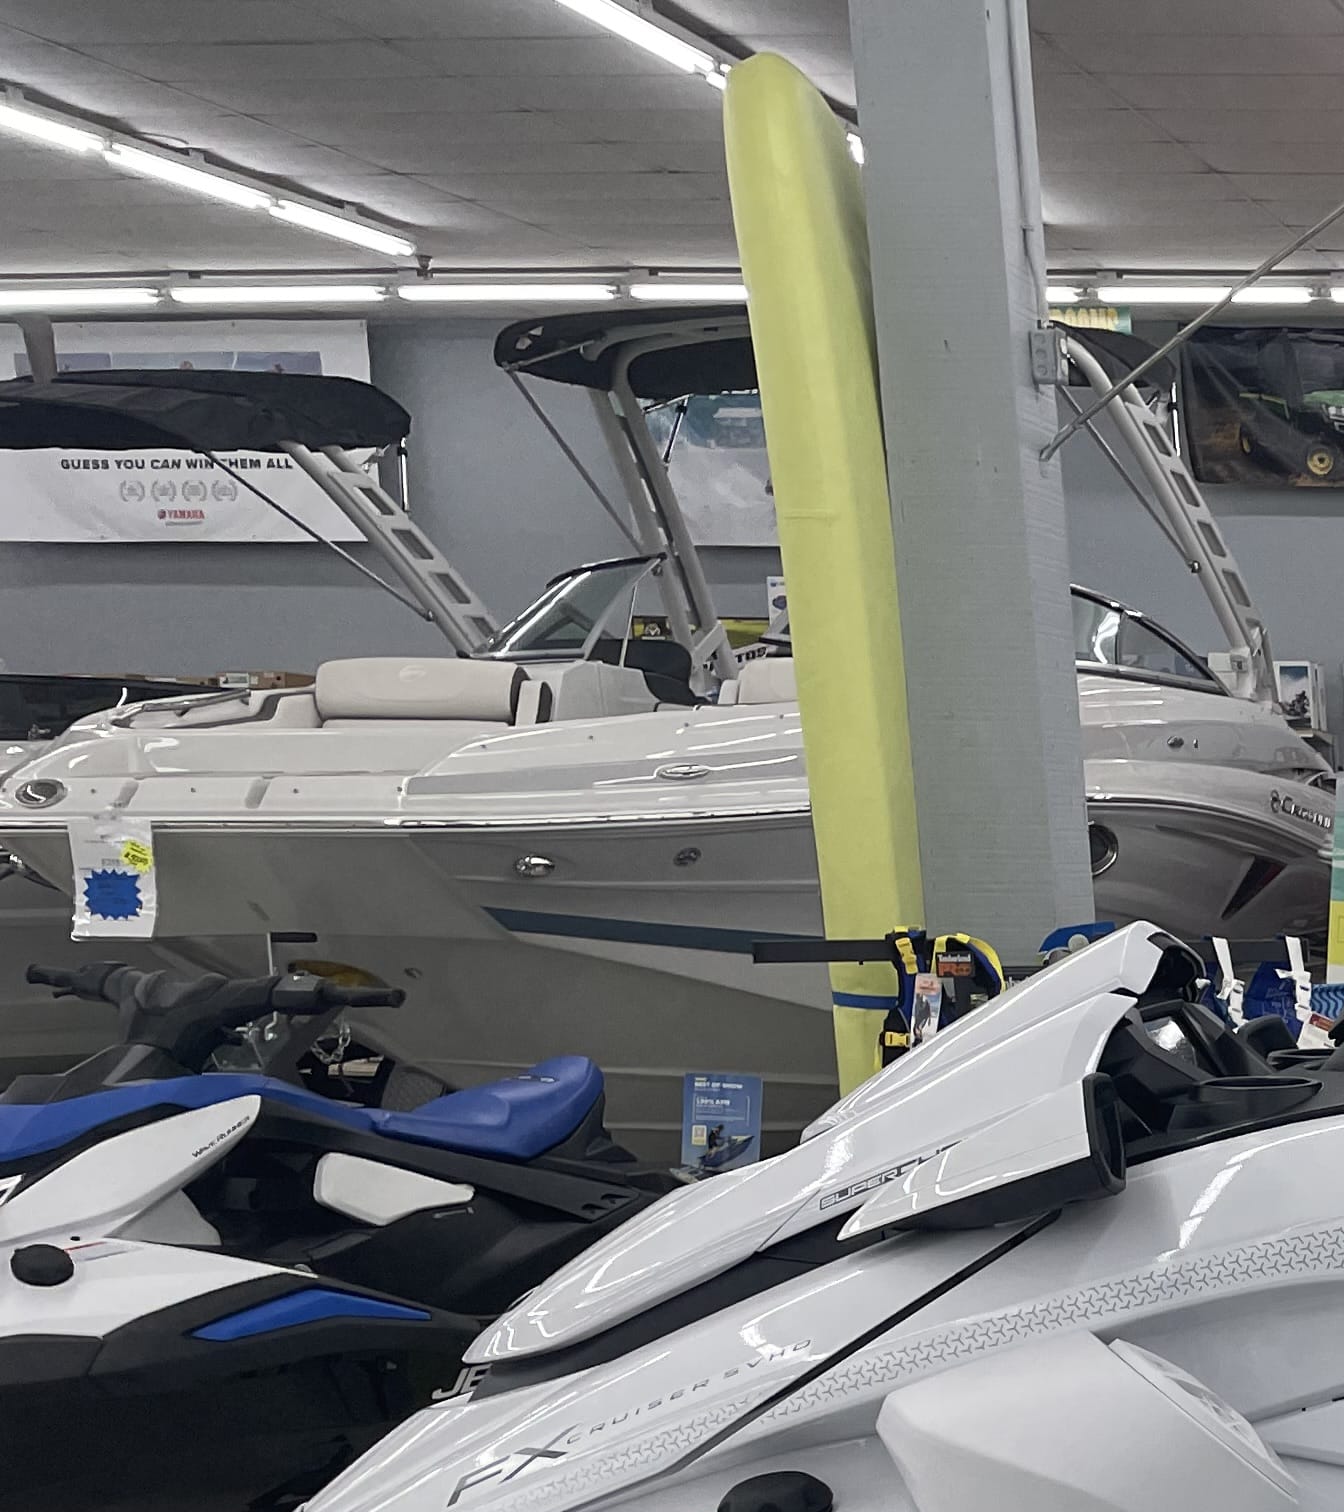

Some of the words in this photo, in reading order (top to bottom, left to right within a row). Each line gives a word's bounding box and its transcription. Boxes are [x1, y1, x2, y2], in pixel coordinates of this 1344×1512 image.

[61, 459, 110, 470] GUESS
[115, 459, 146, 470] YOU
[150, 459, 181, 470] CAN
[186, 458, 215, 469] WIN
[266, 458, 294, 469] ALL
[446, 1422, 582, 1508] FX
[566, 1377, 712, 1445] CRUISER
[722, 1338, 813, 1380] SVHO
